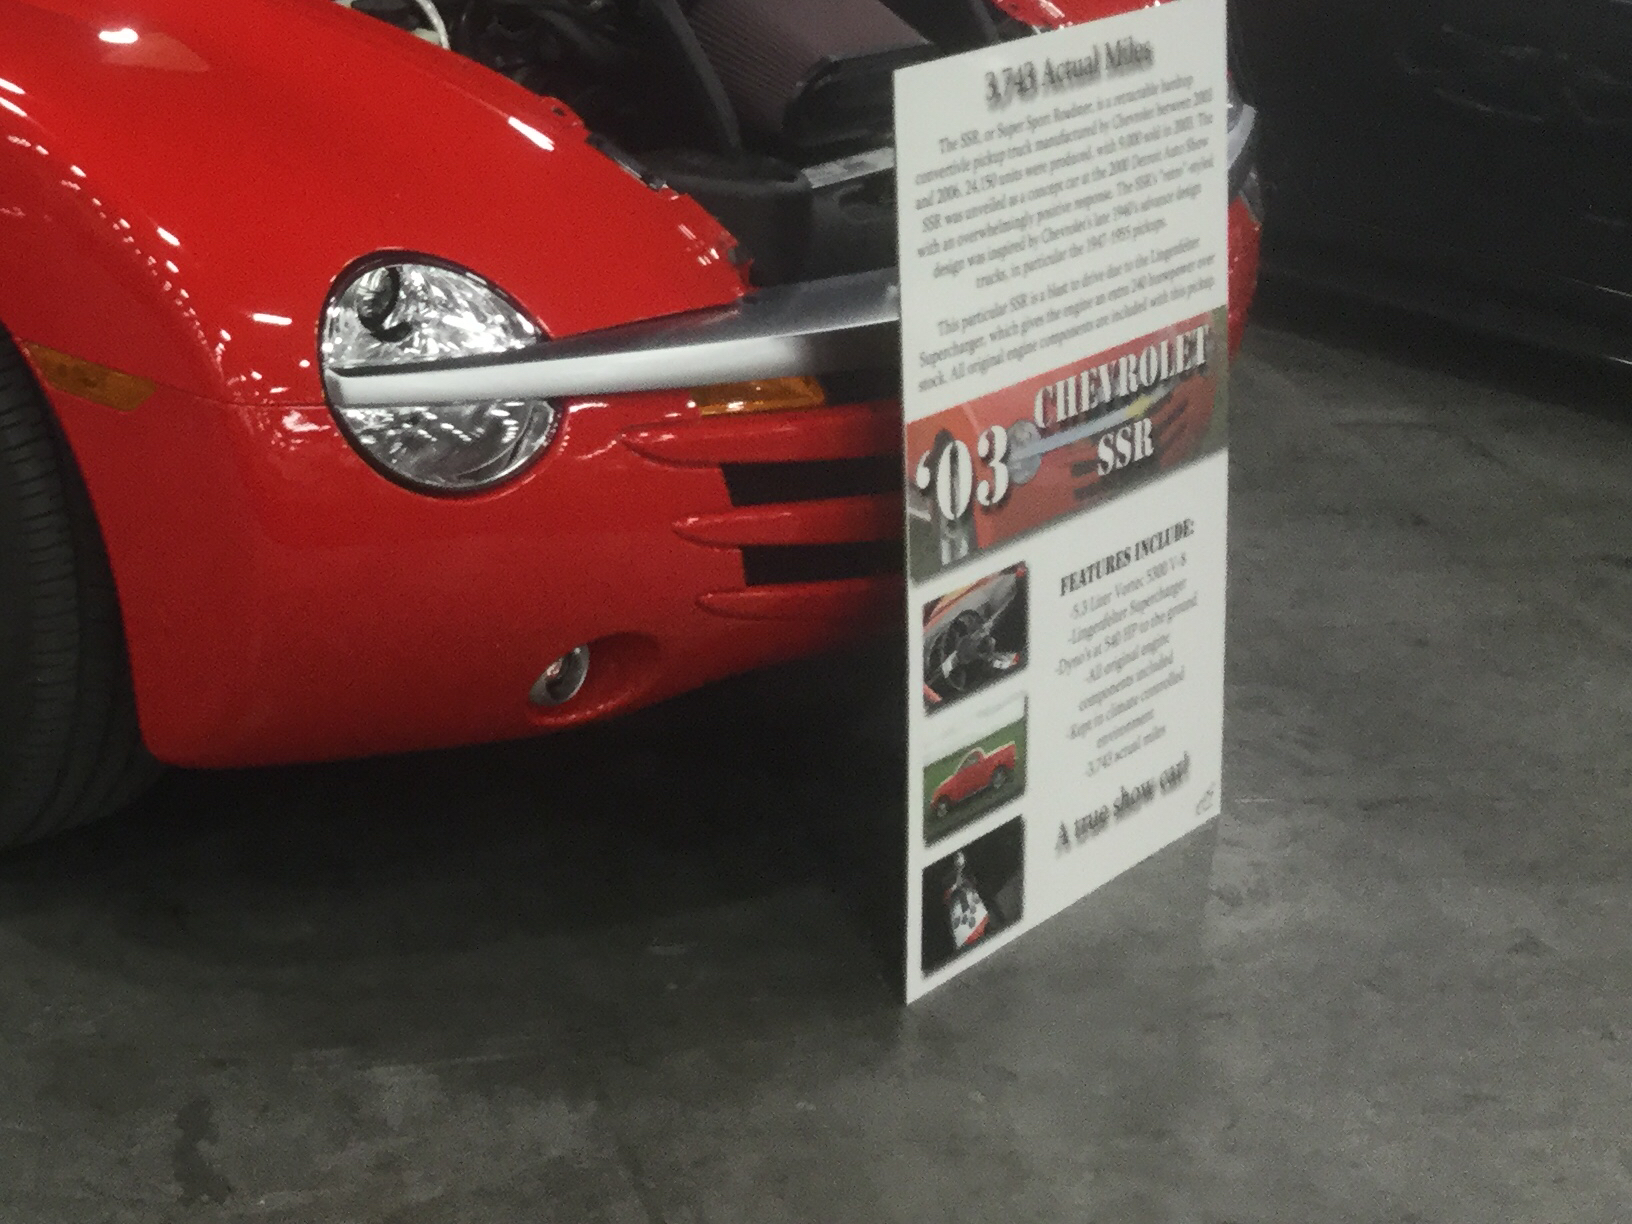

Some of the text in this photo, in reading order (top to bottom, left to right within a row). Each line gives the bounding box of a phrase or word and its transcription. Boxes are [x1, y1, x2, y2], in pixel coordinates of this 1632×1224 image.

[1041, 44, 1100, 86] Actual
[1034, 325, 1209, 429] CHEVROLET
[1097, 417, 1155, 476] SSR
[1059, 518, 1194, 597] FEATURES INCLUDE:
